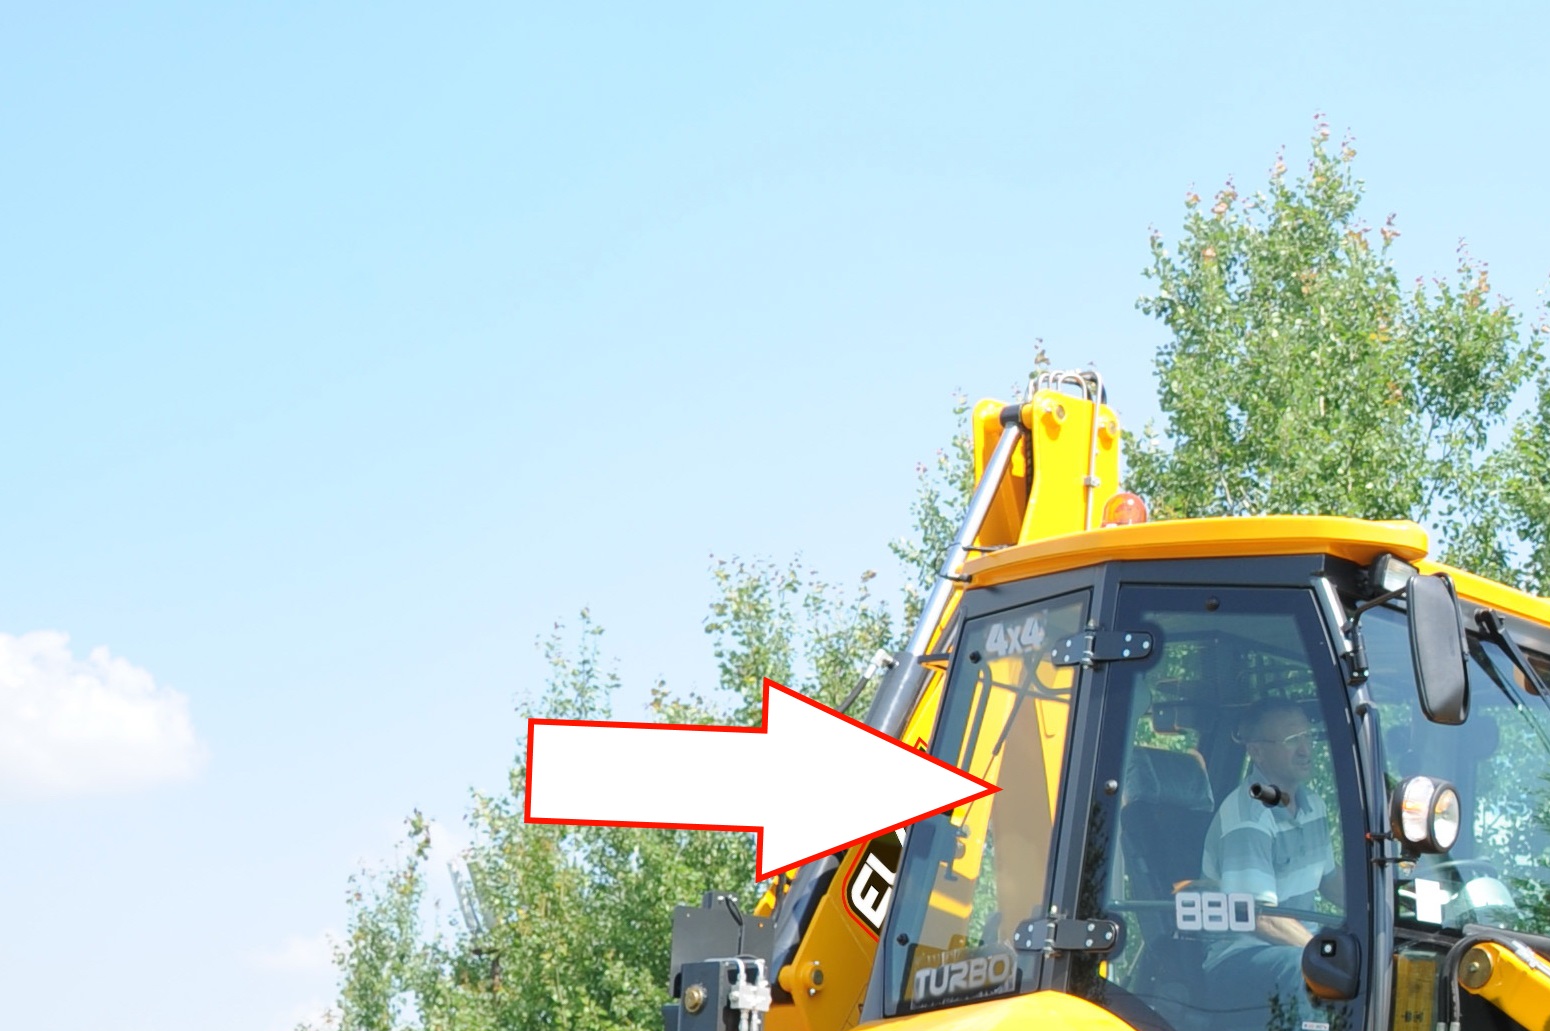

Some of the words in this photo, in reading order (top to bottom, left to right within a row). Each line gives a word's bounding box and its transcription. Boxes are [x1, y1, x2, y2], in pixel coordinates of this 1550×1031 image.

[851, 836, 905, 929] EL
[1175, 892, 1256, 932] 880
[914, 954, 1010, 1001] TURBO
